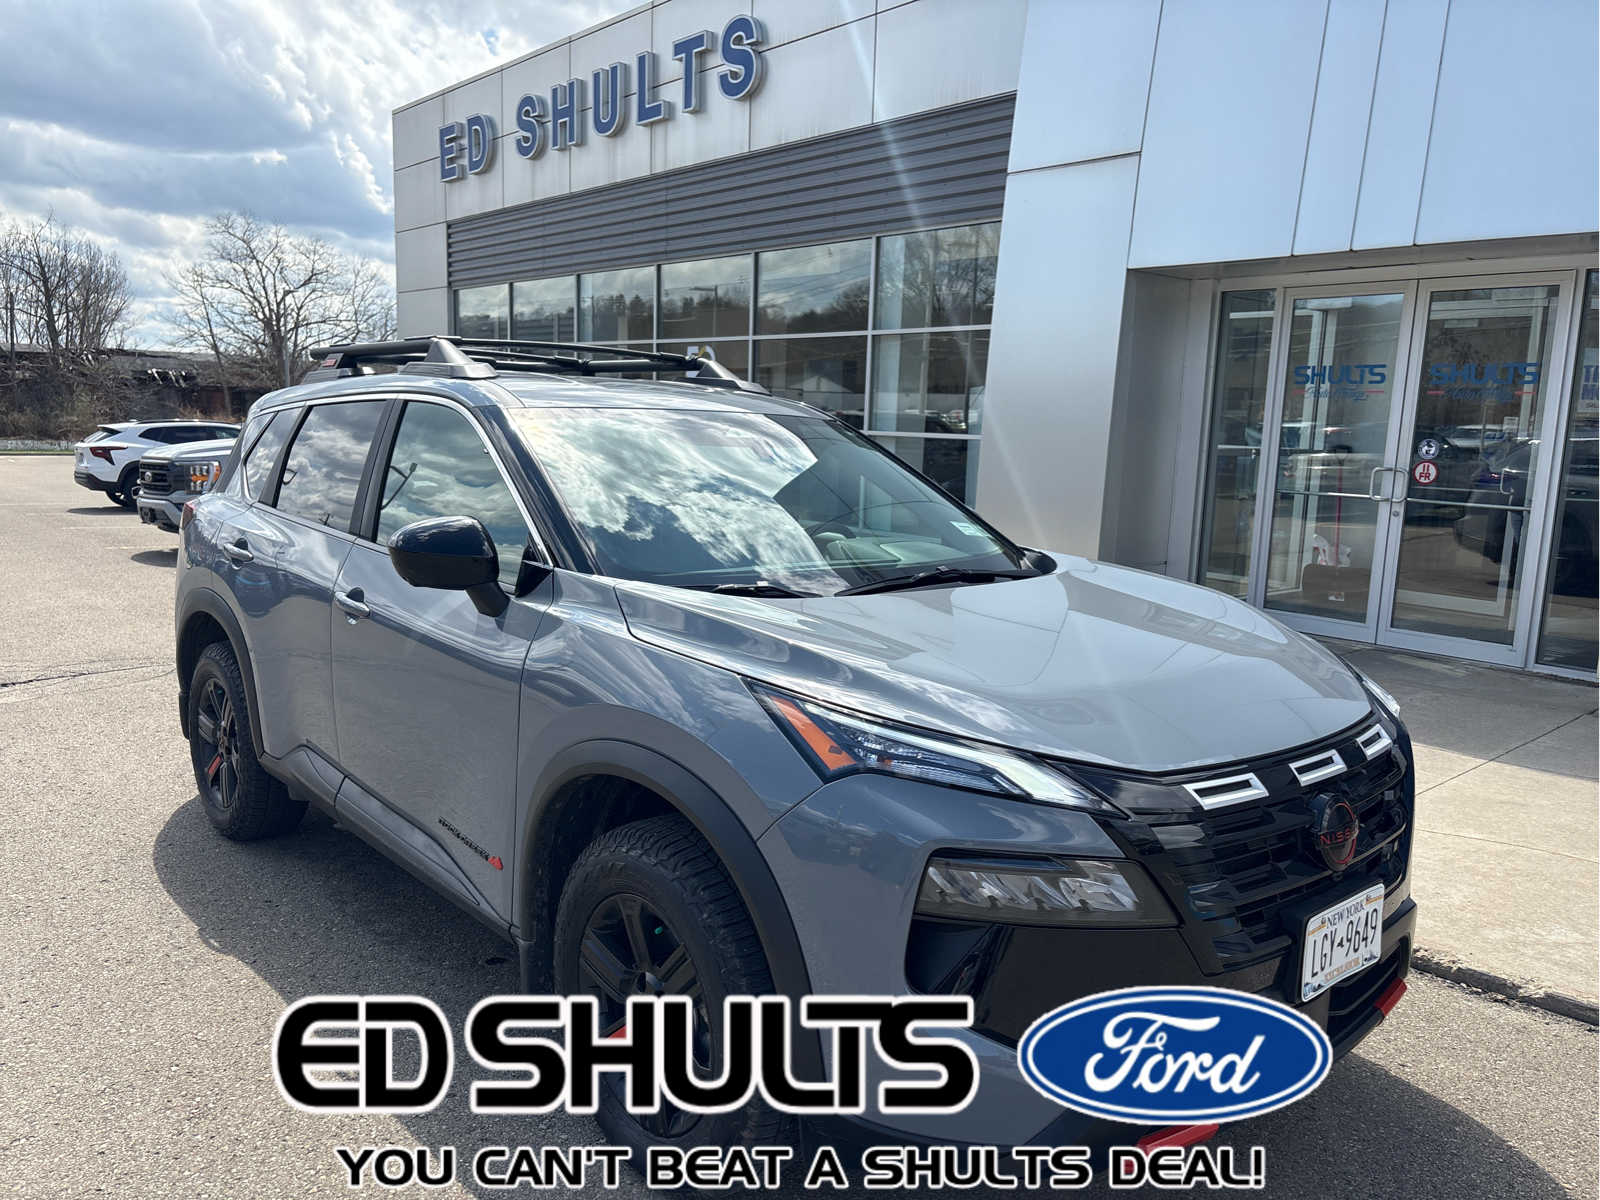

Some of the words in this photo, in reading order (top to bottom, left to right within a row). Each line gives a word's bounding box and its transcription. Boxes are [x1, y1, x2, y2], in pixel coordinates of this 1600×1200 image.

[439, 112, 495, 182] ED
[515, 14, 763, 160] SHULTS
[1293, 363, 1388, 385] SHULTS
[1429, 361, 1539, 385] SHULTS
[1418, 472, 1431, 481] FR
[1326, 908, 1345, 929] NEW
[1345, 900, 1365, 919] YORK
